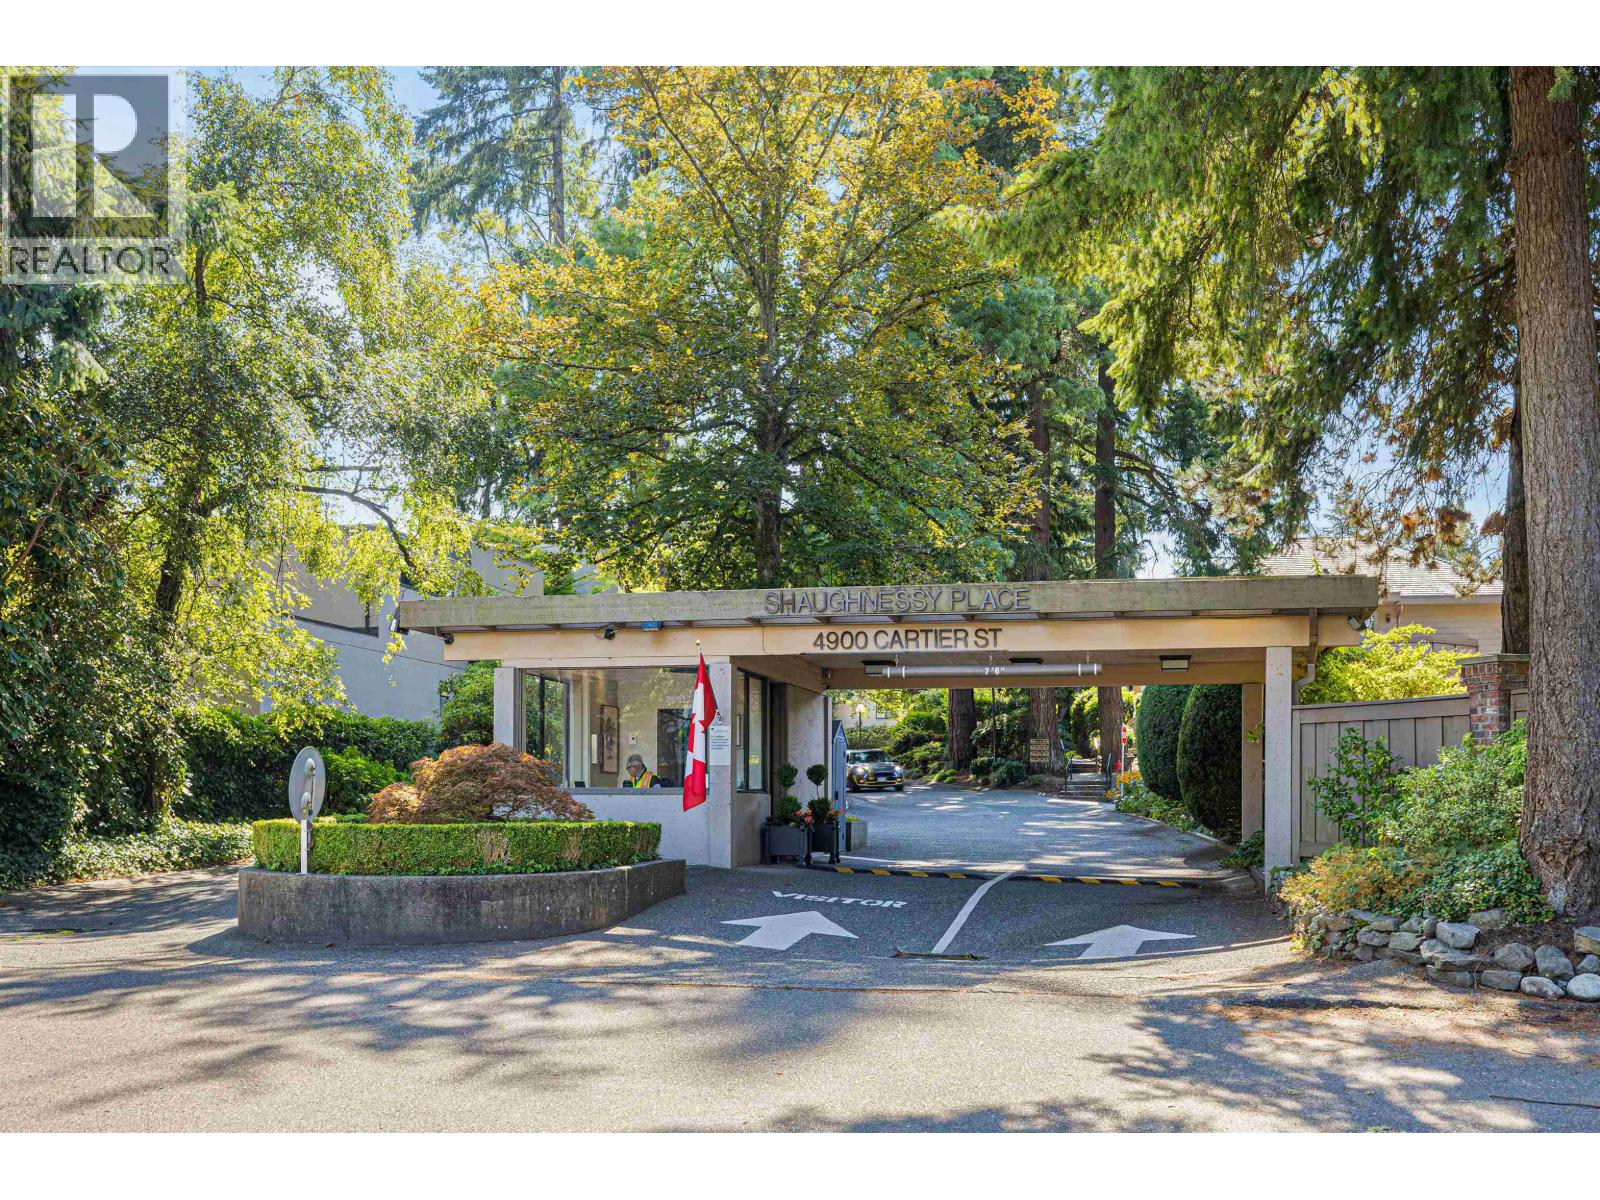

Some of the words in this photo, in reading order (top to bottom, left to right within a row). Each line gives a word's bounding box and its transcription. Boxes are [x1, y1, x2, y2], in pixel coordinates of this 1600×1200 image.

[764, 589, 942, 615] SHAUGHNESSY
[949, 588, 1031, 611] PLACE
[812, 630, 870, 651] 4900
[872, 628, 970, 650] CARTIER
[972, 628, 1003, 649] ST
[772, 890, 908, 908] VISITOR
